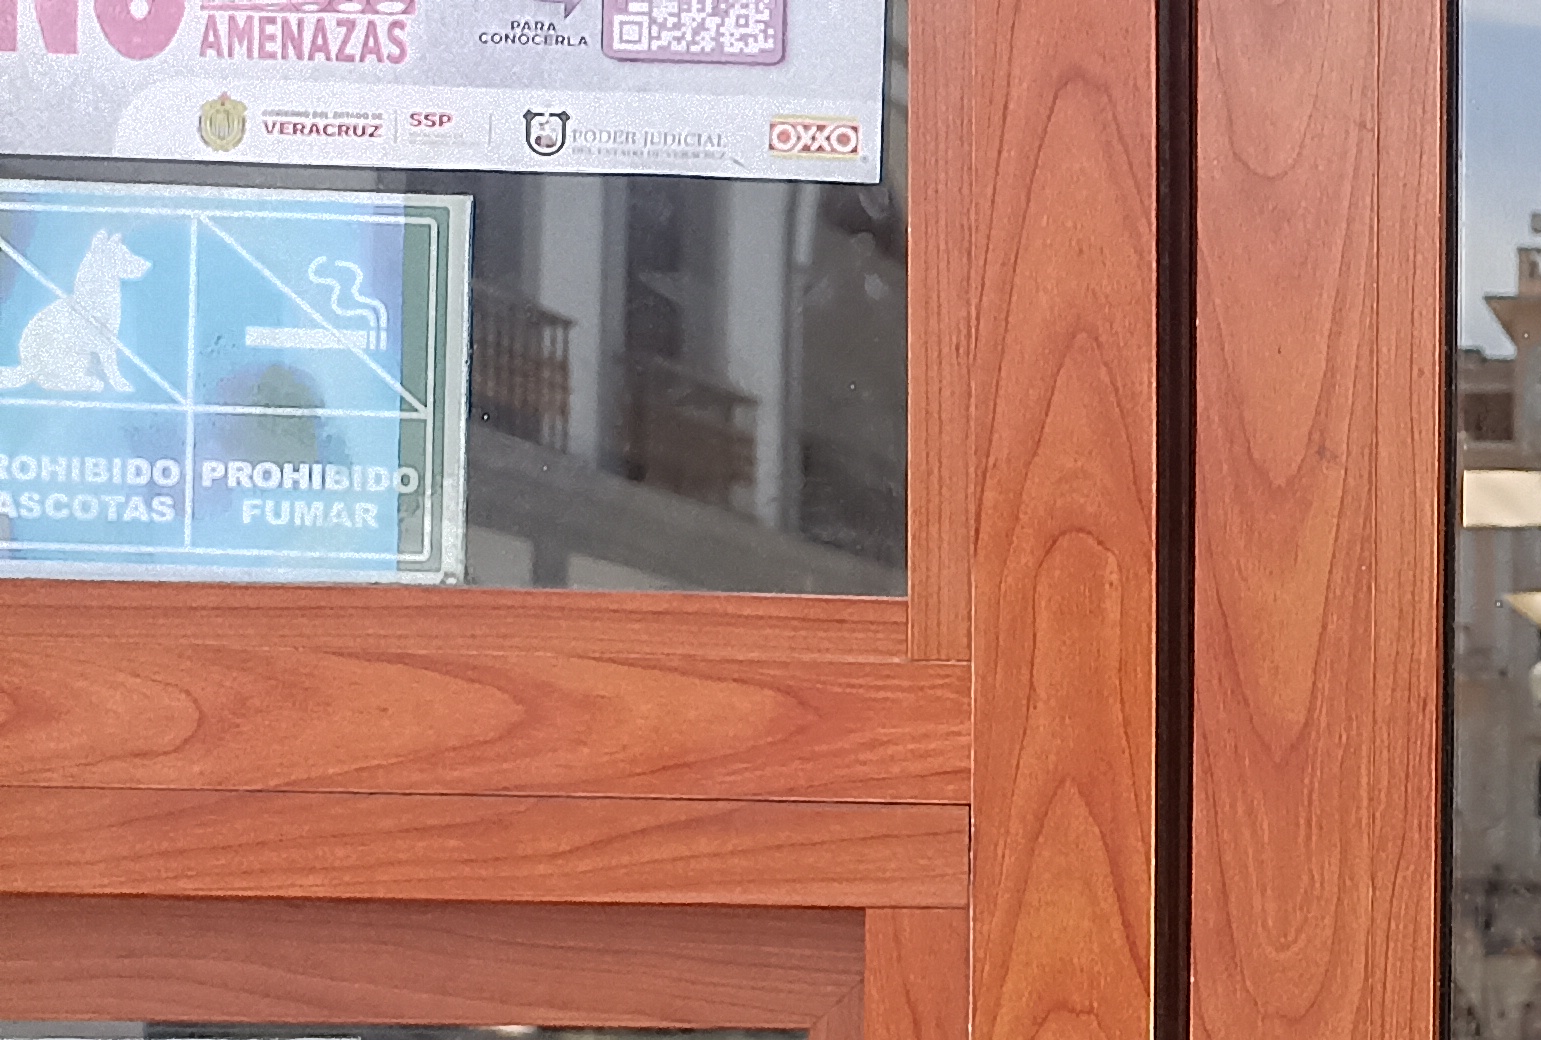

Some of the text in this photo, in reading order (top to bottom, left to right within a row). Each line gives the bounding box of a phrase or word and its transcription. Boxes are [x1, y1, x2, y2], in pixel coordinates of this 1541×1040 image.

[510, 20, 556, 32] PARA
[198, 14, 408, 64] AMENAZAS
[478, 32, 589, 47] CONOCERLA
[263, 120, 383, 138] VERACRUZ
[408, 112, 453, 128] SSP
[572, 128, 727, 148] PODER JUDICIAL
[769, 122, 859, 153] OXXO
[0, 454, 181, 488] OHIBIDO
[201, 460, 420, 494] PROHIBIDO
[242, 498, 379, 528] FUMAR
